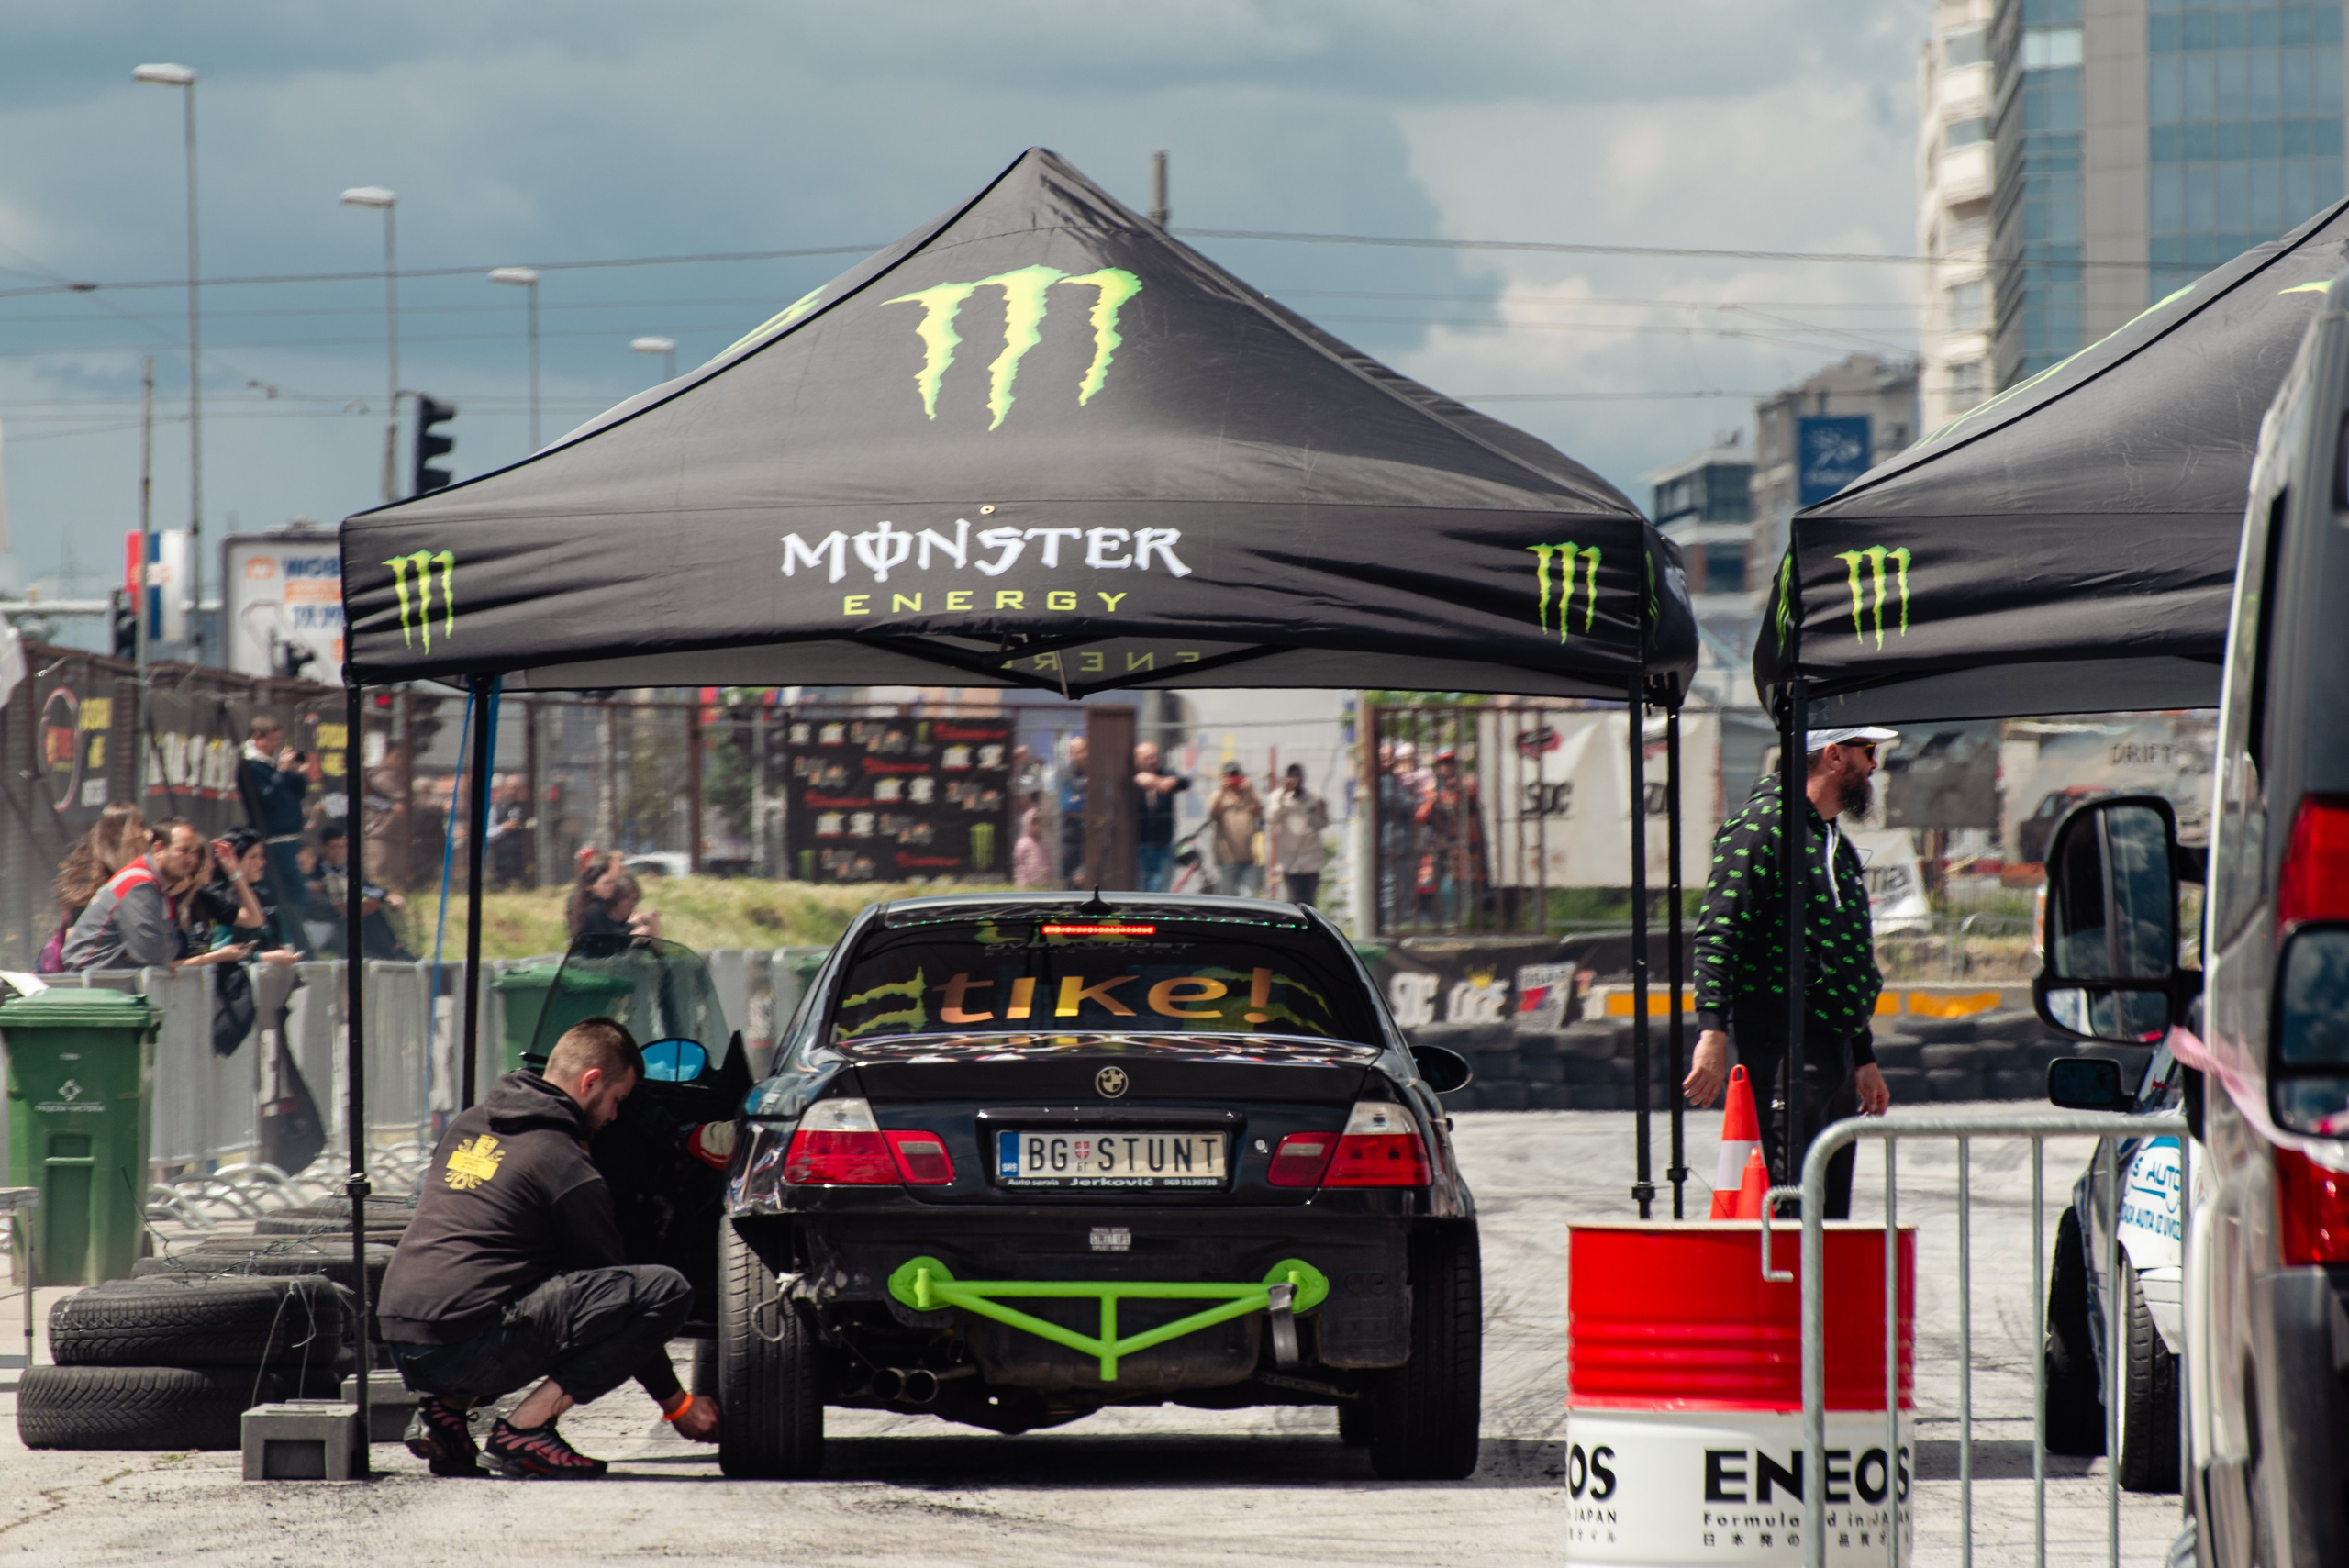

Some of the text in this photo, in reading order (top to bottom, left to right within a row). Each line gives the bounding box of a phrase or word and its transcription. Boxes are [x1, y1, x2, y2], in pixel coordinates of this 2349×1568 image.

[780, 517, 1193, 584] MONSTER
[843, 590, 1127, 617] ENERGY
[2110, 743, 2176, 765] DRIFT
[1001, 1162, 1018, 1173] SRB
[1029, 1138, 1218, 1173] BG STUNT
[1070, 1177, 1154, 1186] Jerković
[1705, 1446, 1909, 1503] ENEOS
[1848, 1511, 1865, 1528] in
